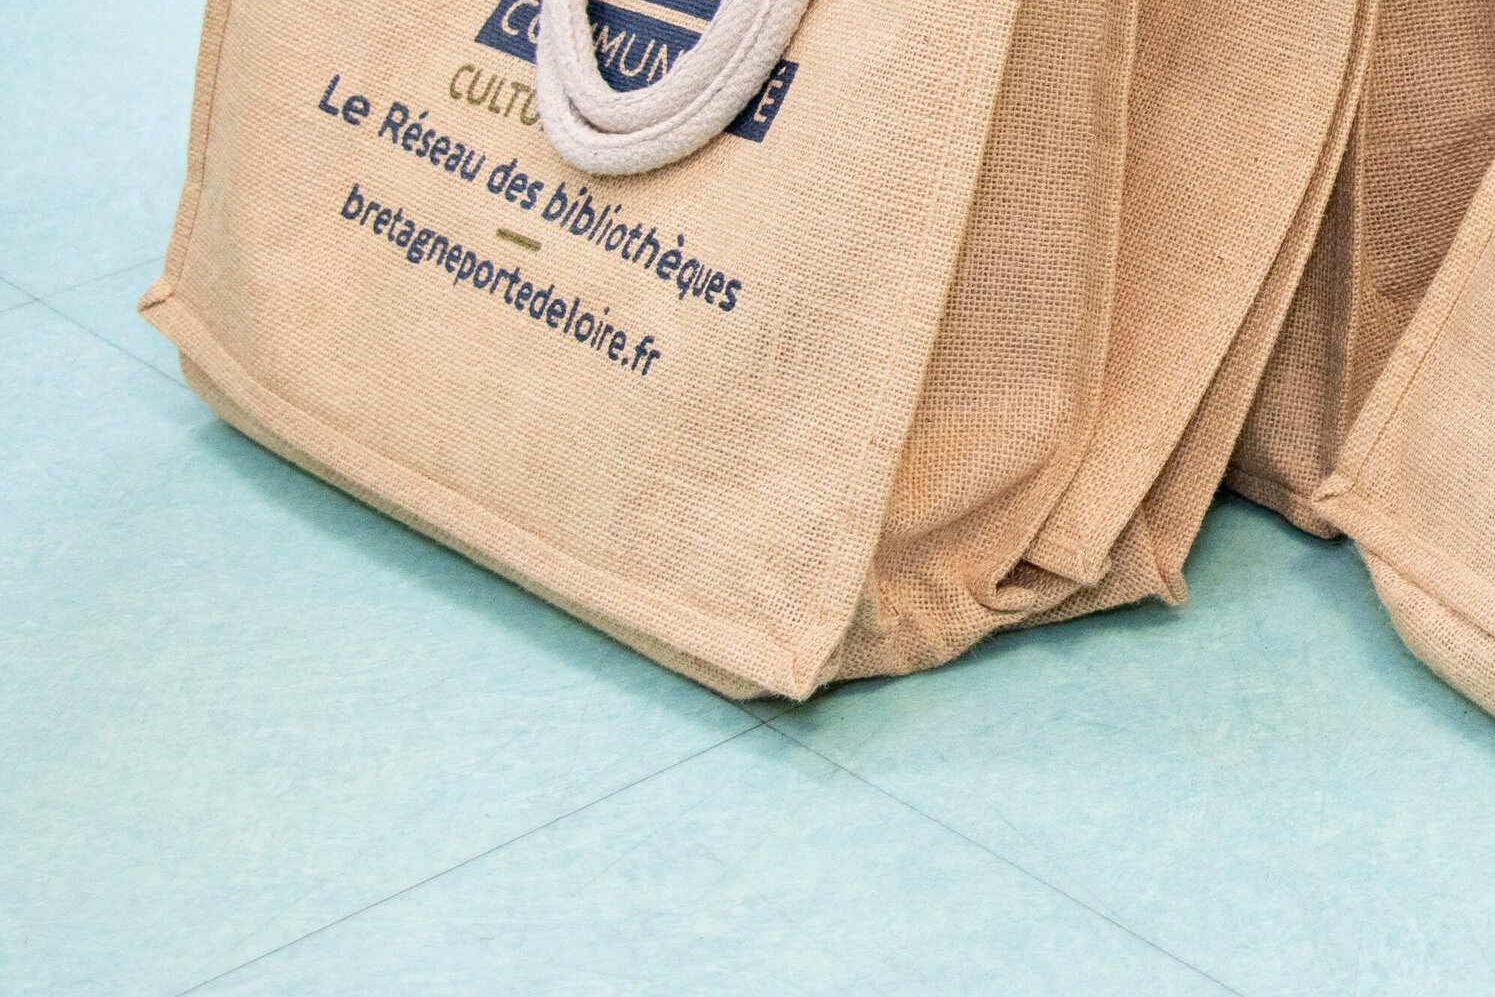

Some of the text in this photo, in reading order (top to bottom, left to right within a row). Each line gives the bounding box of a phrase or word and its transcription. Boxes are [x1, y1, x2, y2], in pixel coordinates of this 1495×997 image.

[319, 73, 743, 312] Le Réseau des bibliothèques
[341, 182, 662, 377] bretagneportedeloire.fr
